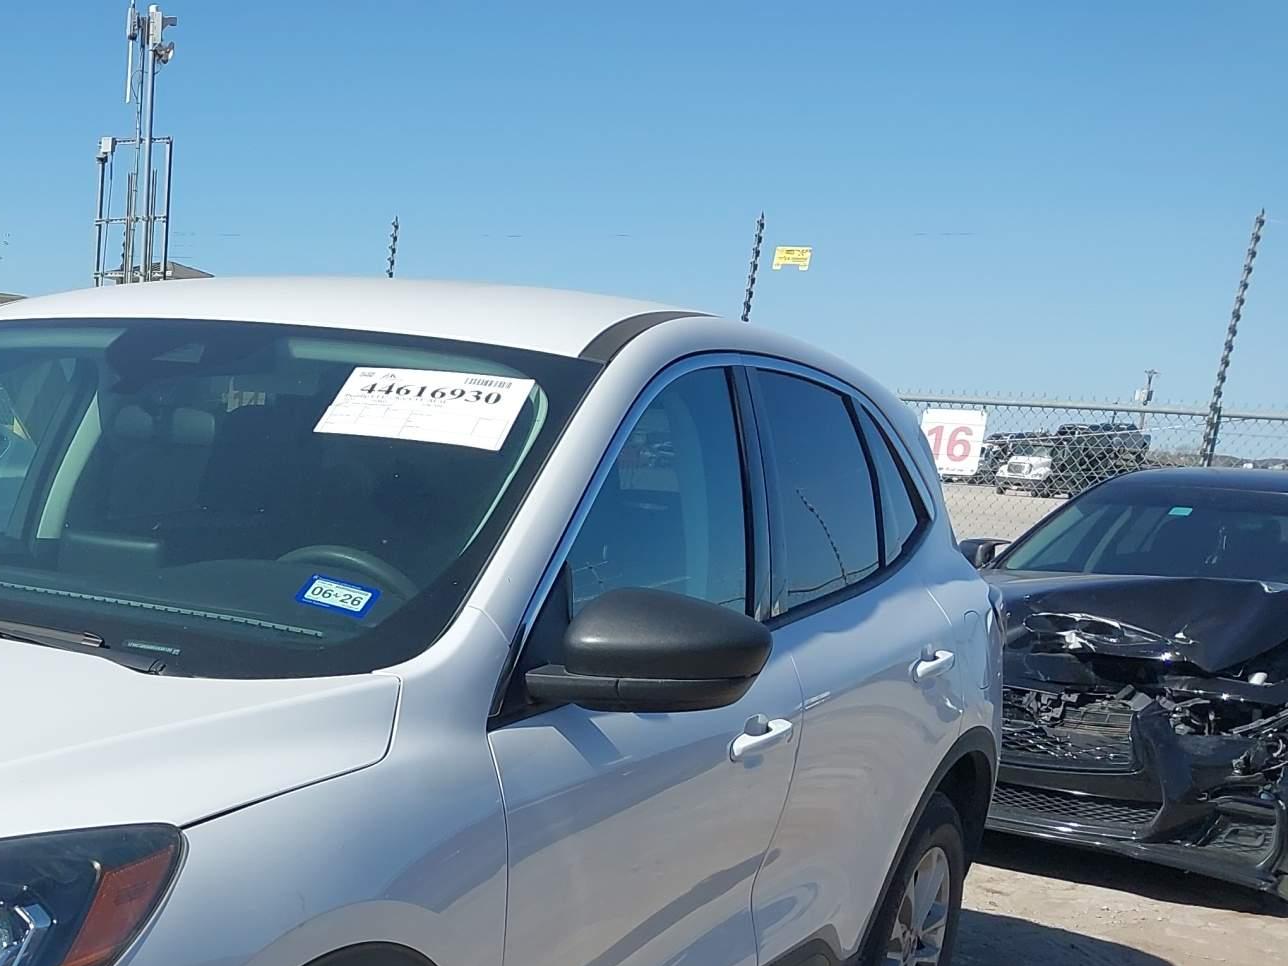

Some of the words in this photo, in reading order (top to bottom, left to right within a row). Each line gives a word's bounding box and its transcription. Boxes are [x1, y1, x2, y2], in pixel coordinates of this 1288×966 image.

[360, 382, 503, 405] 44616930
[927, 425, 974, 462] 16
[311, 586, 333, 599] 06
[339, 593, 364, 606] 26
